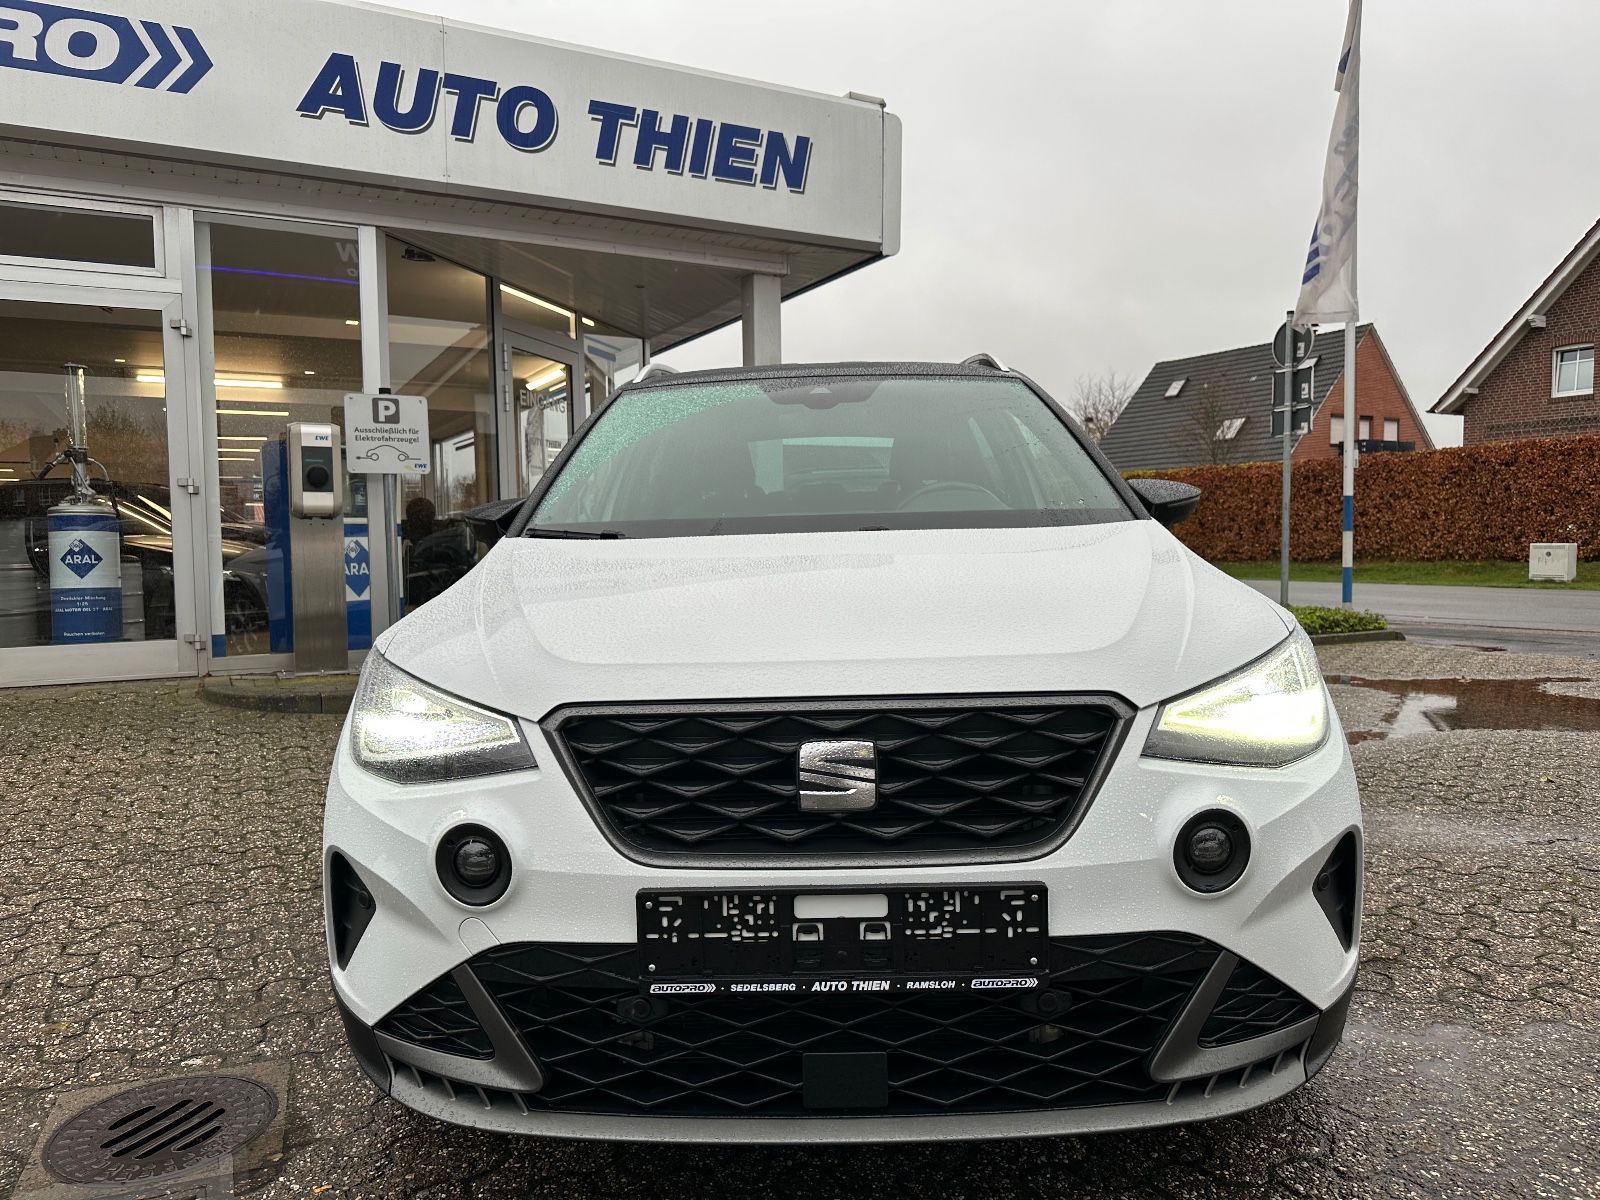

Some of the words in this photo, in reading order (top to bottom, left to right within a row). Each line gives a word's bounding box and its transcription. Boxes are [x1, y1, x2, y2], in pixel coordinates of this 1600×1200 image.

[295, 52, 559, 154] AUTO
[587, 99, 814, 195] THIEN
[377, 400, 397, 422] P
[354, 427, 408, 435] Ausschließlich
[65, 554, 99, 564] ARAL
[730, 983, 797, 992] SEDELSBERG
[811, 981, 848, 992] AUTO
[851, 980, 891, 991] THIEN
[906, 980, 956, 989] RAMSLOH
